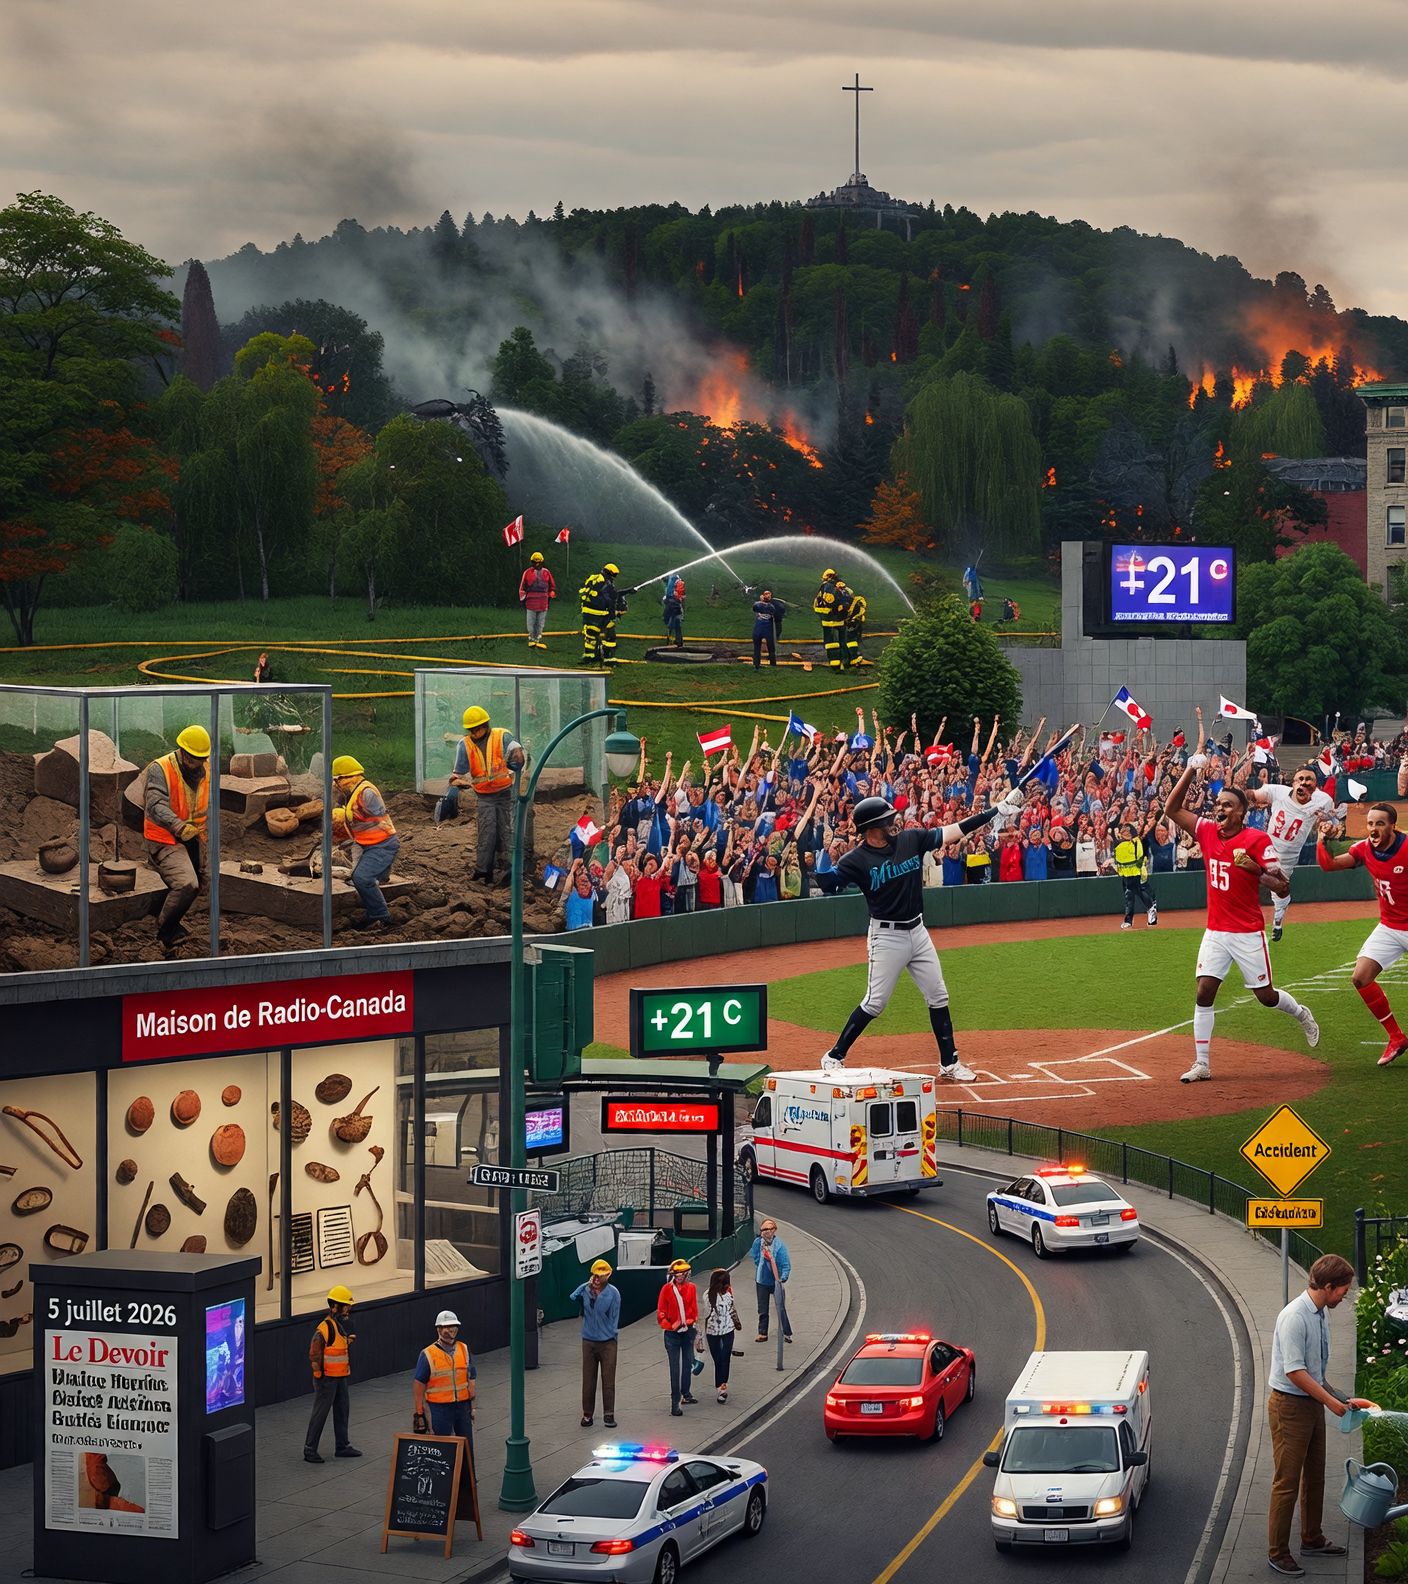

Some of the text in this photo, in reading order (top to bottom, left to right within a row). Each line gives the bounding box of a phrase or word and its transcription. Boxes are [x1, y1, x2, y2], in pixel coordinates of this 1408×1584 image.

[136, 990, 407, 1038] Maison de Radio-Canada
[650, 999, 742, 1039] +21 C
[1254, 1142, 1318, 1158] Accident
[47, 1298, 177, 1327] 5 juillet 2026
[52, 1335, 170, 1368] Le Devoir
